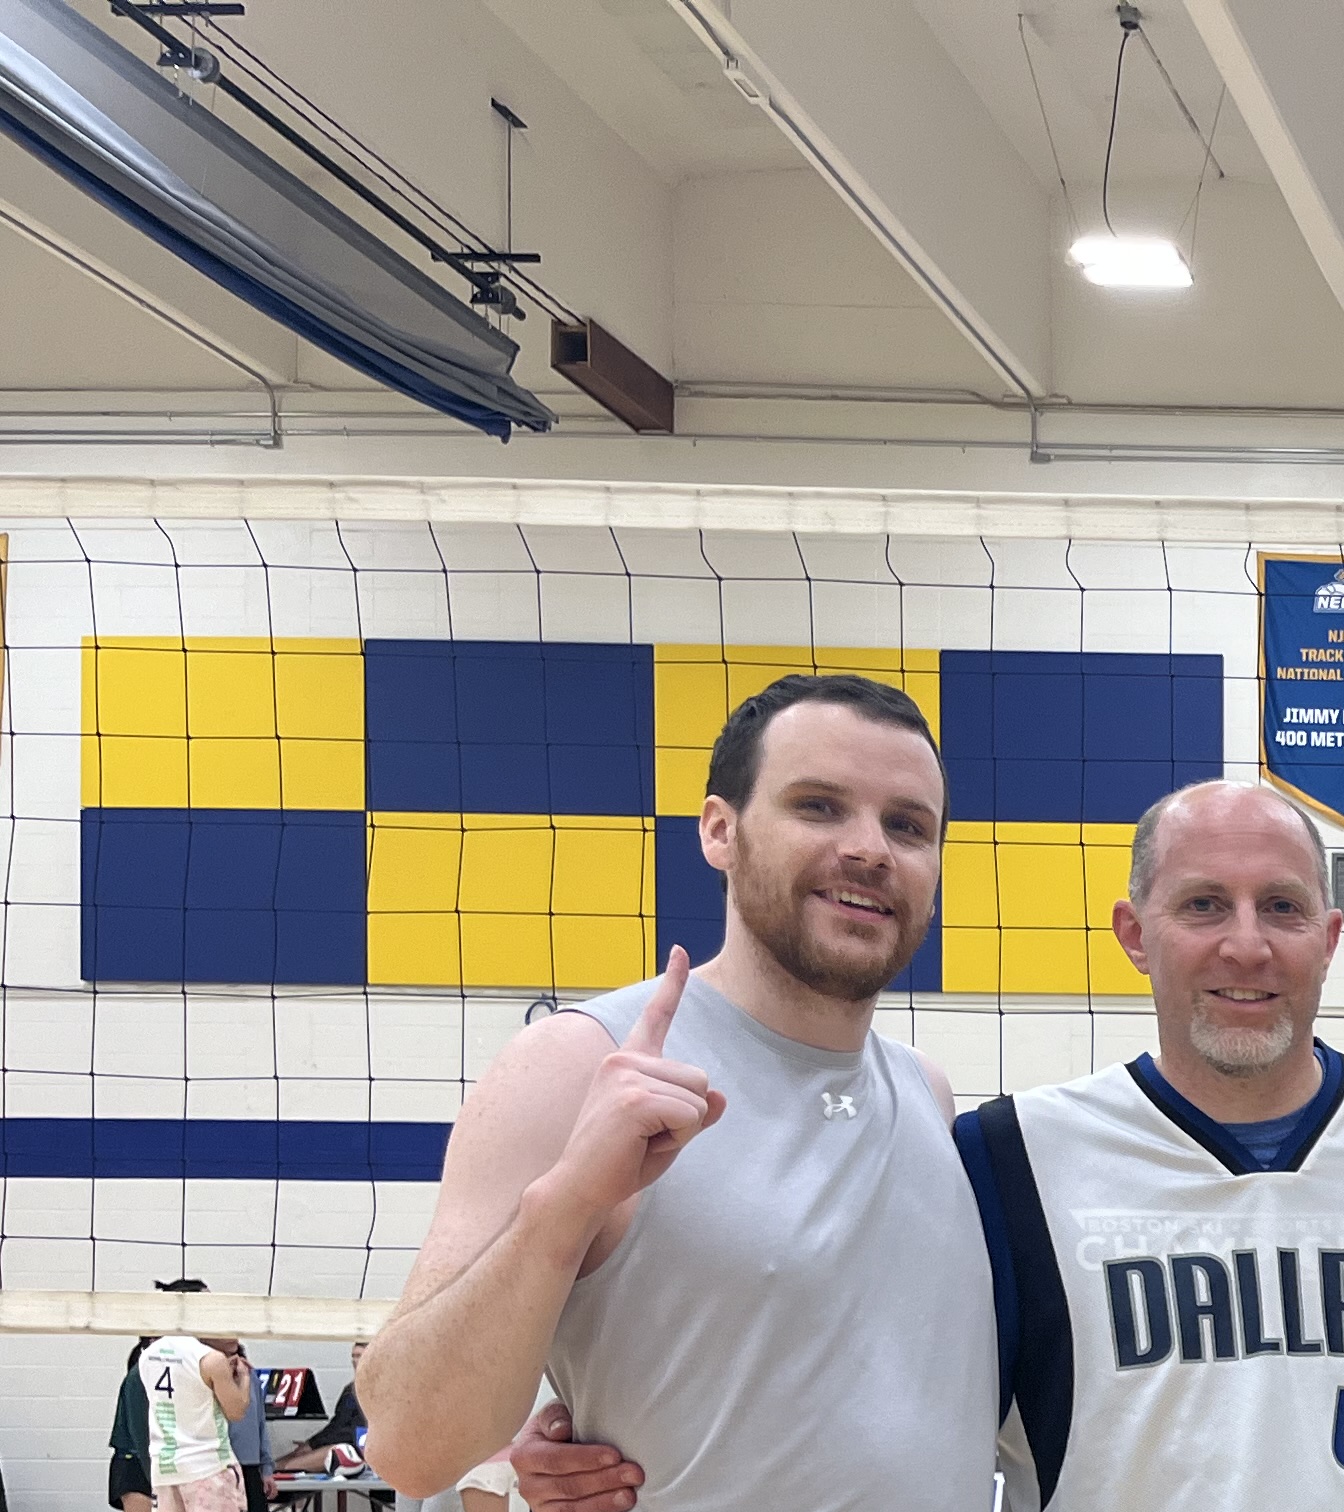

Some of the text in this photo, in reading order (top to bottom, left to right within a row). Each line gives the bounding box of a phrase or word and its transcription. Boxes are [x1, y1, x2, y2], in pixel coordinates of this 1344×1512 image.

[1300, 648, 1344, 663] TRACK
[1276, 667, 1344, 681] NATIONAL
[1282, 706, 1339, 725] JIMMY
[1275, 730, 1308, 747] 400
[154, 1366, 174, 1399] 4
[276, 1371, 303, 1404] 21
